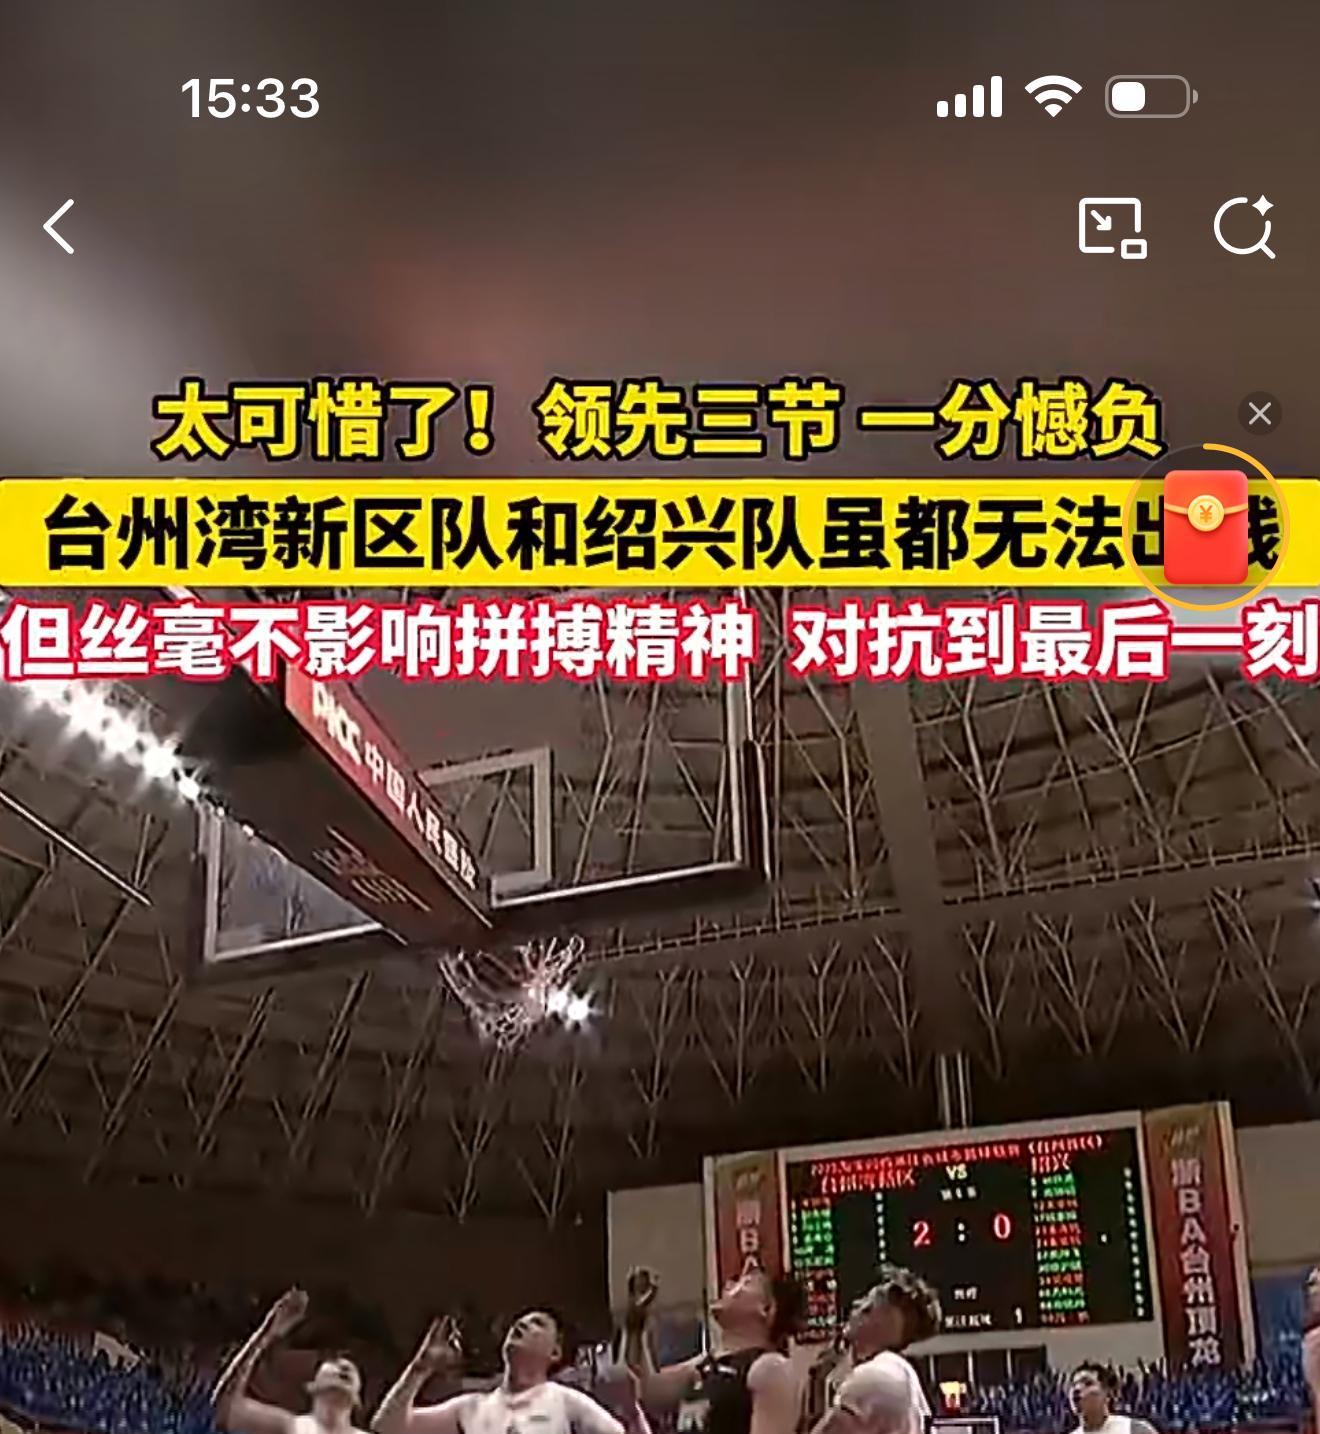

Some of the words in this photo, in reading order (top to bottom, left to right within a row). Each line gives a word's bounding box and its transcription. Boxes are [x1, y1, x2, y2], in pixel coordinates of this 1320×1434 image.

[945, 1163, 968, 1180] VS
[912, 1220, 931, 1247] 2
[993, 1213, 1012, 1239] 0
